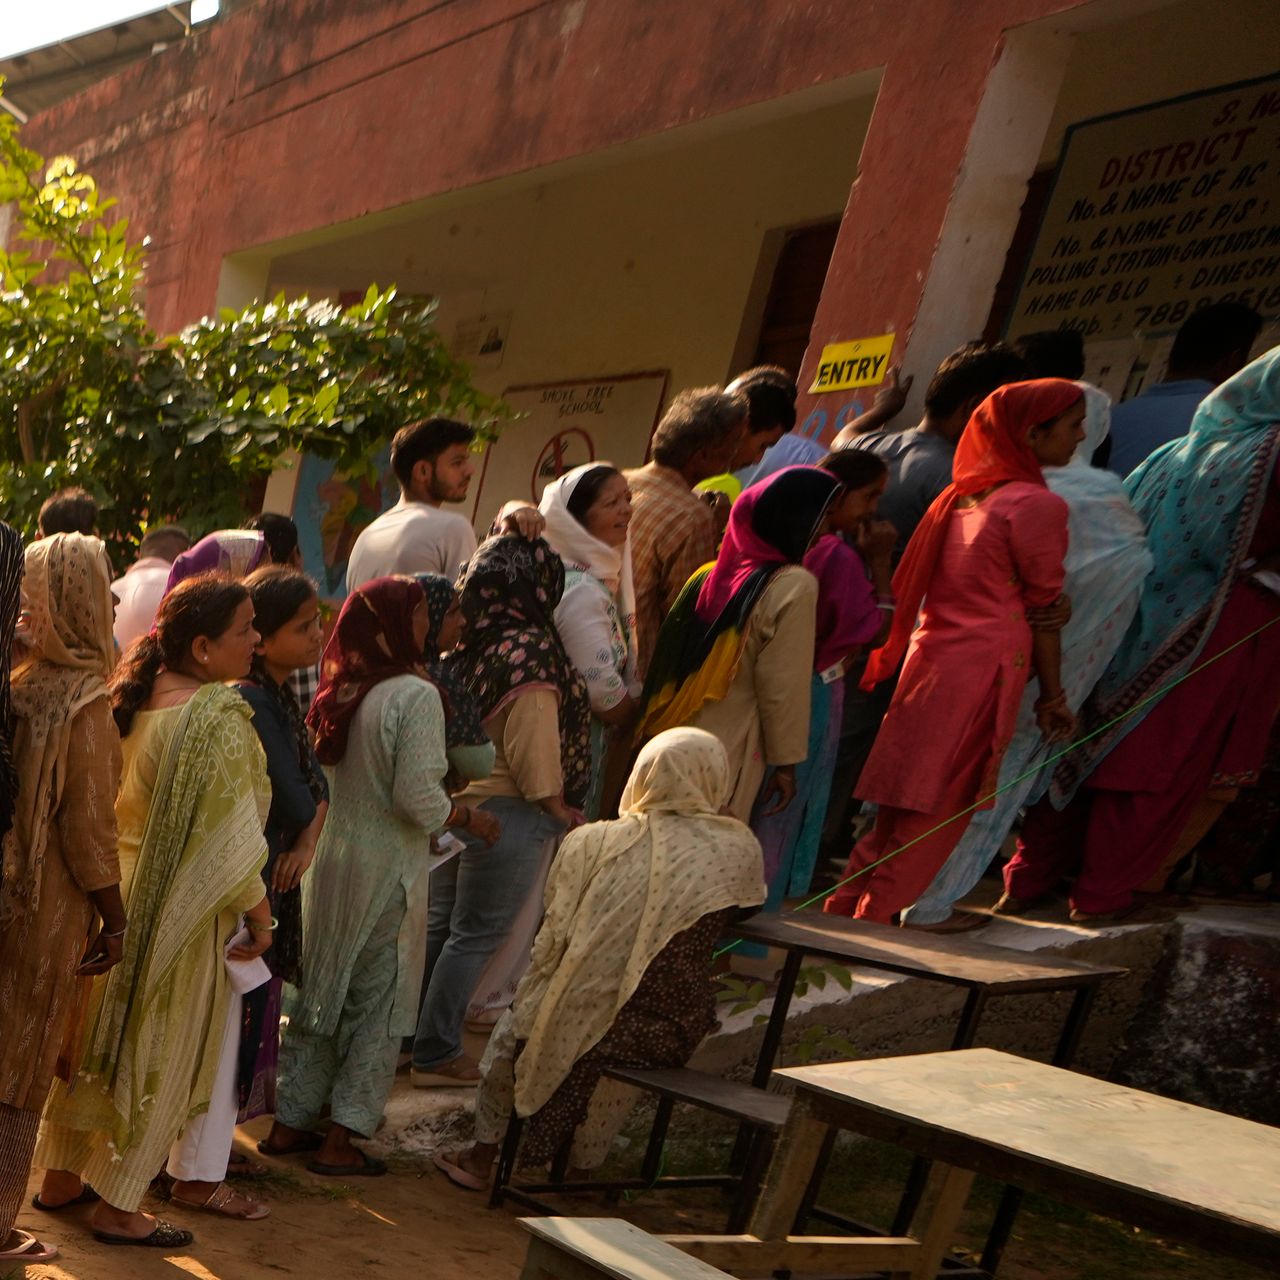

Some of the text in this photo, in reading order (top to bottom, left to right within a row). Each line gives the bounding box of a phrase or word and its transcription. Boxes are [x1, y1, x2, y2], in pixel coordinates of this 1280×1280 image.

[1098, 128, 1256, 189] DISTRICT
[1066, 161, 1268, 223] No. & NAME OF AC
[1051, 236, 1081, 258] No.
[1176, 207, 1209, 235] OF
[1208, 197, 1258, 231] P/S
[1023, 287, 1078, 316] NAME
[1079, 283, 1104, 306] OF
[1105, 277, 1150, 304] BLO
[1190, 257, 1280, 290] DINESH
[1027, 256, 1099, 287] POLLING
[585, 384, 615, 400] FREE
[818, 354, 887, 386] ENTRY
[559, 400, 604, 417] SCHOOL
